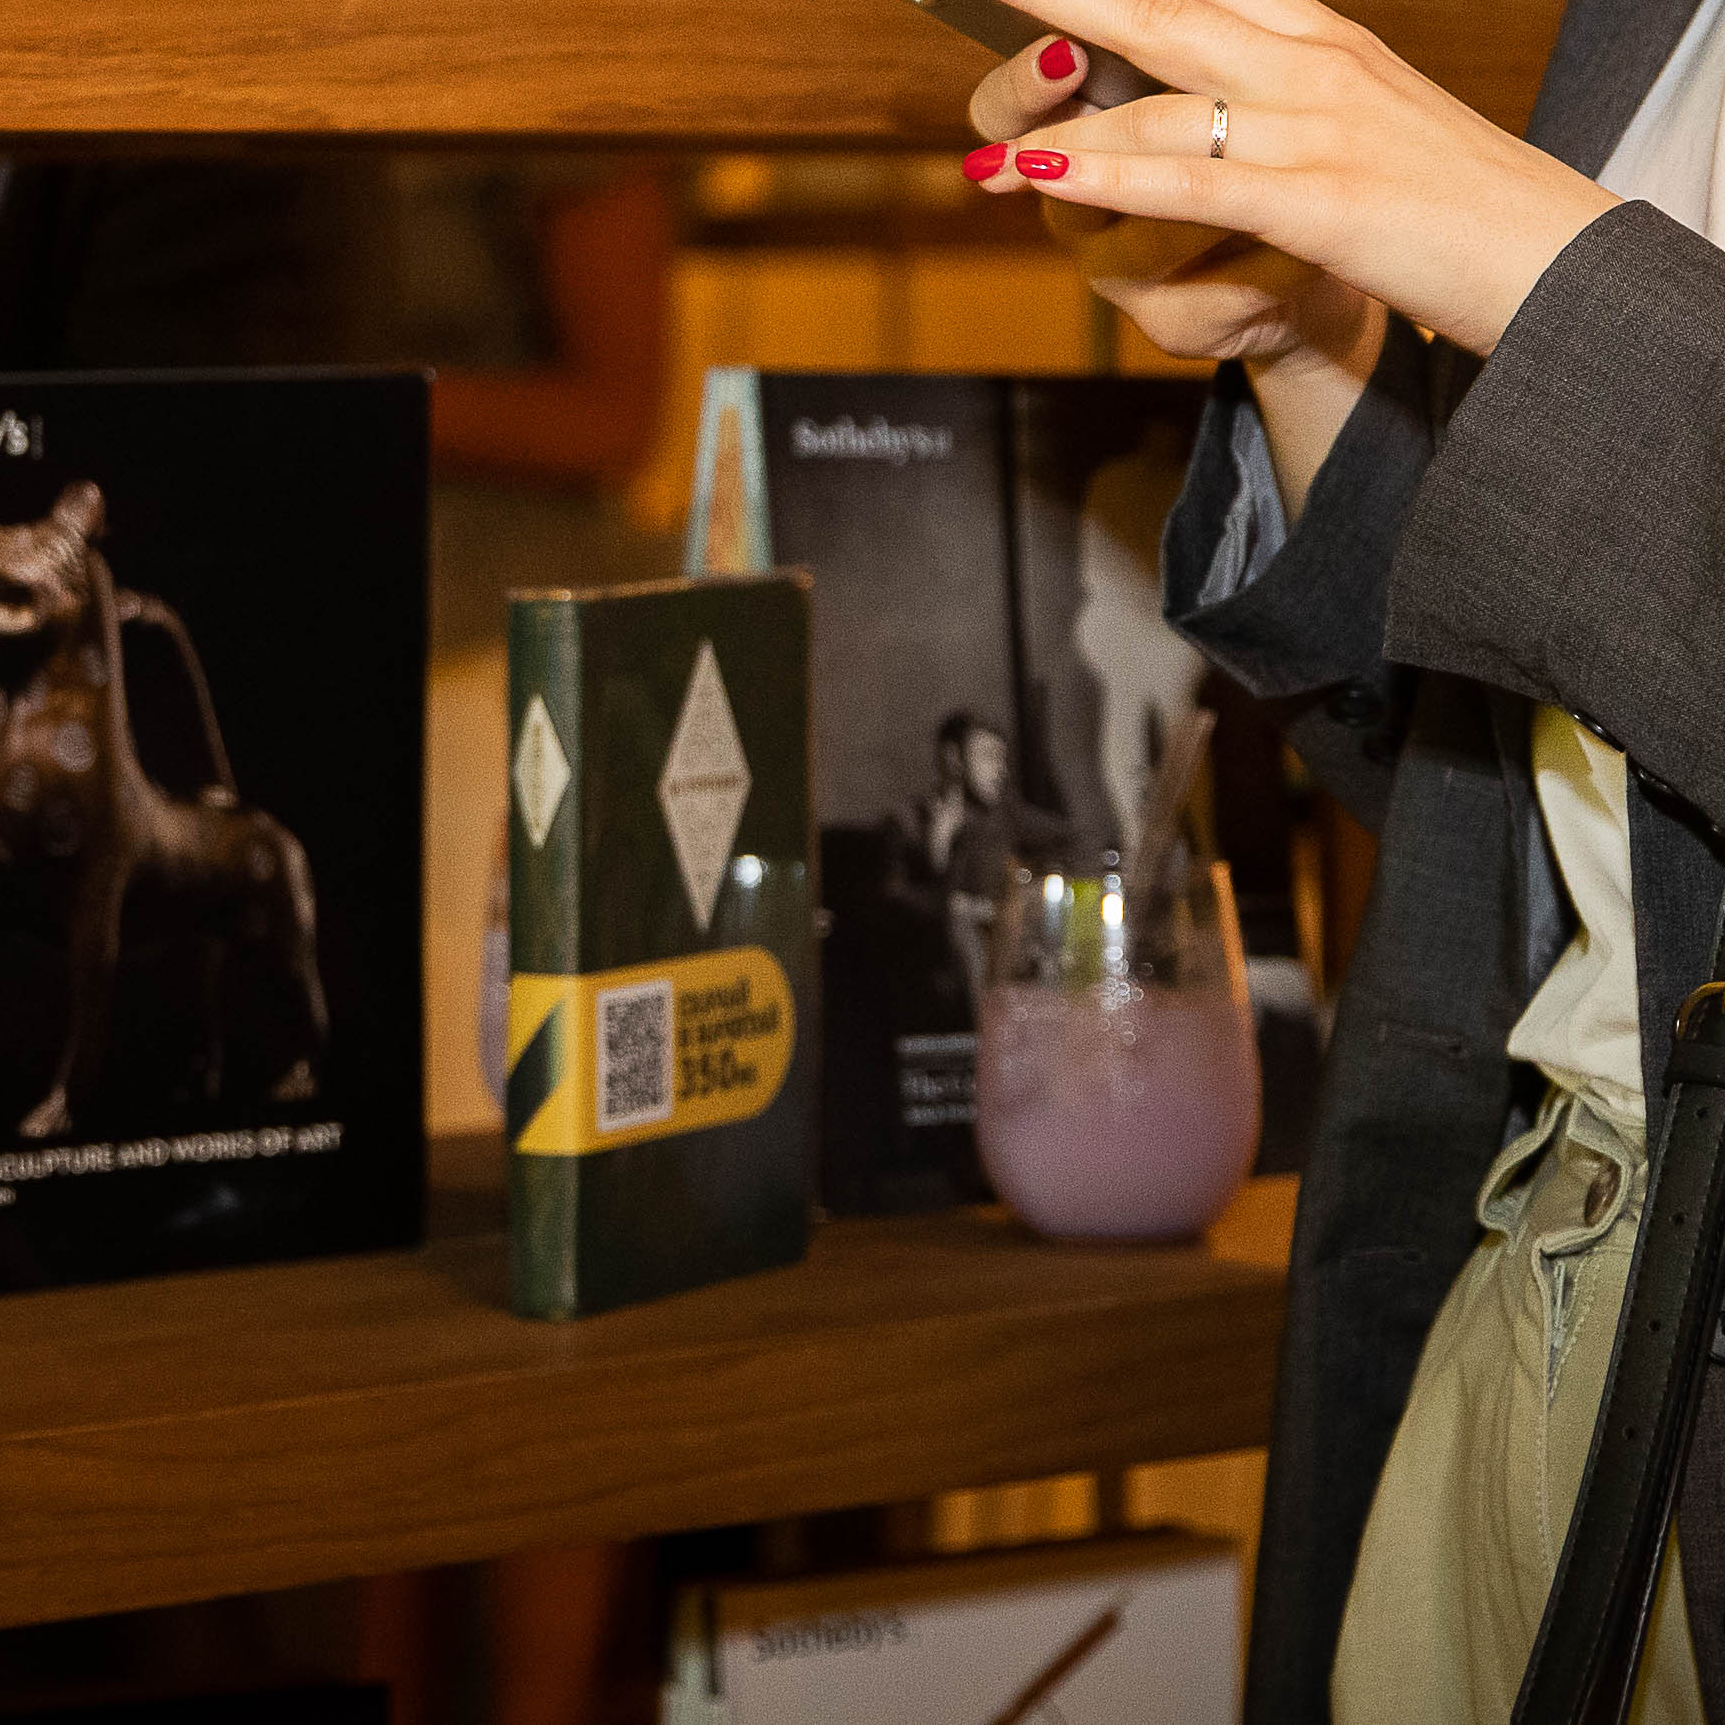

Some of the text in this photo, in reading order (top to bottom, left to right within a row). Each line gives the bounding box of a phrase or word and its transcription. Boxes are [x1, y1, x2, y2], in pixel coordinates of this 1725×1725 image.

[117, 1136, 170, 1170] AND
[171, 1129, 255, 1164] WORKS
[255, 1125, 293, 1157] OF
[294, 1120, 344, 1154] ART
